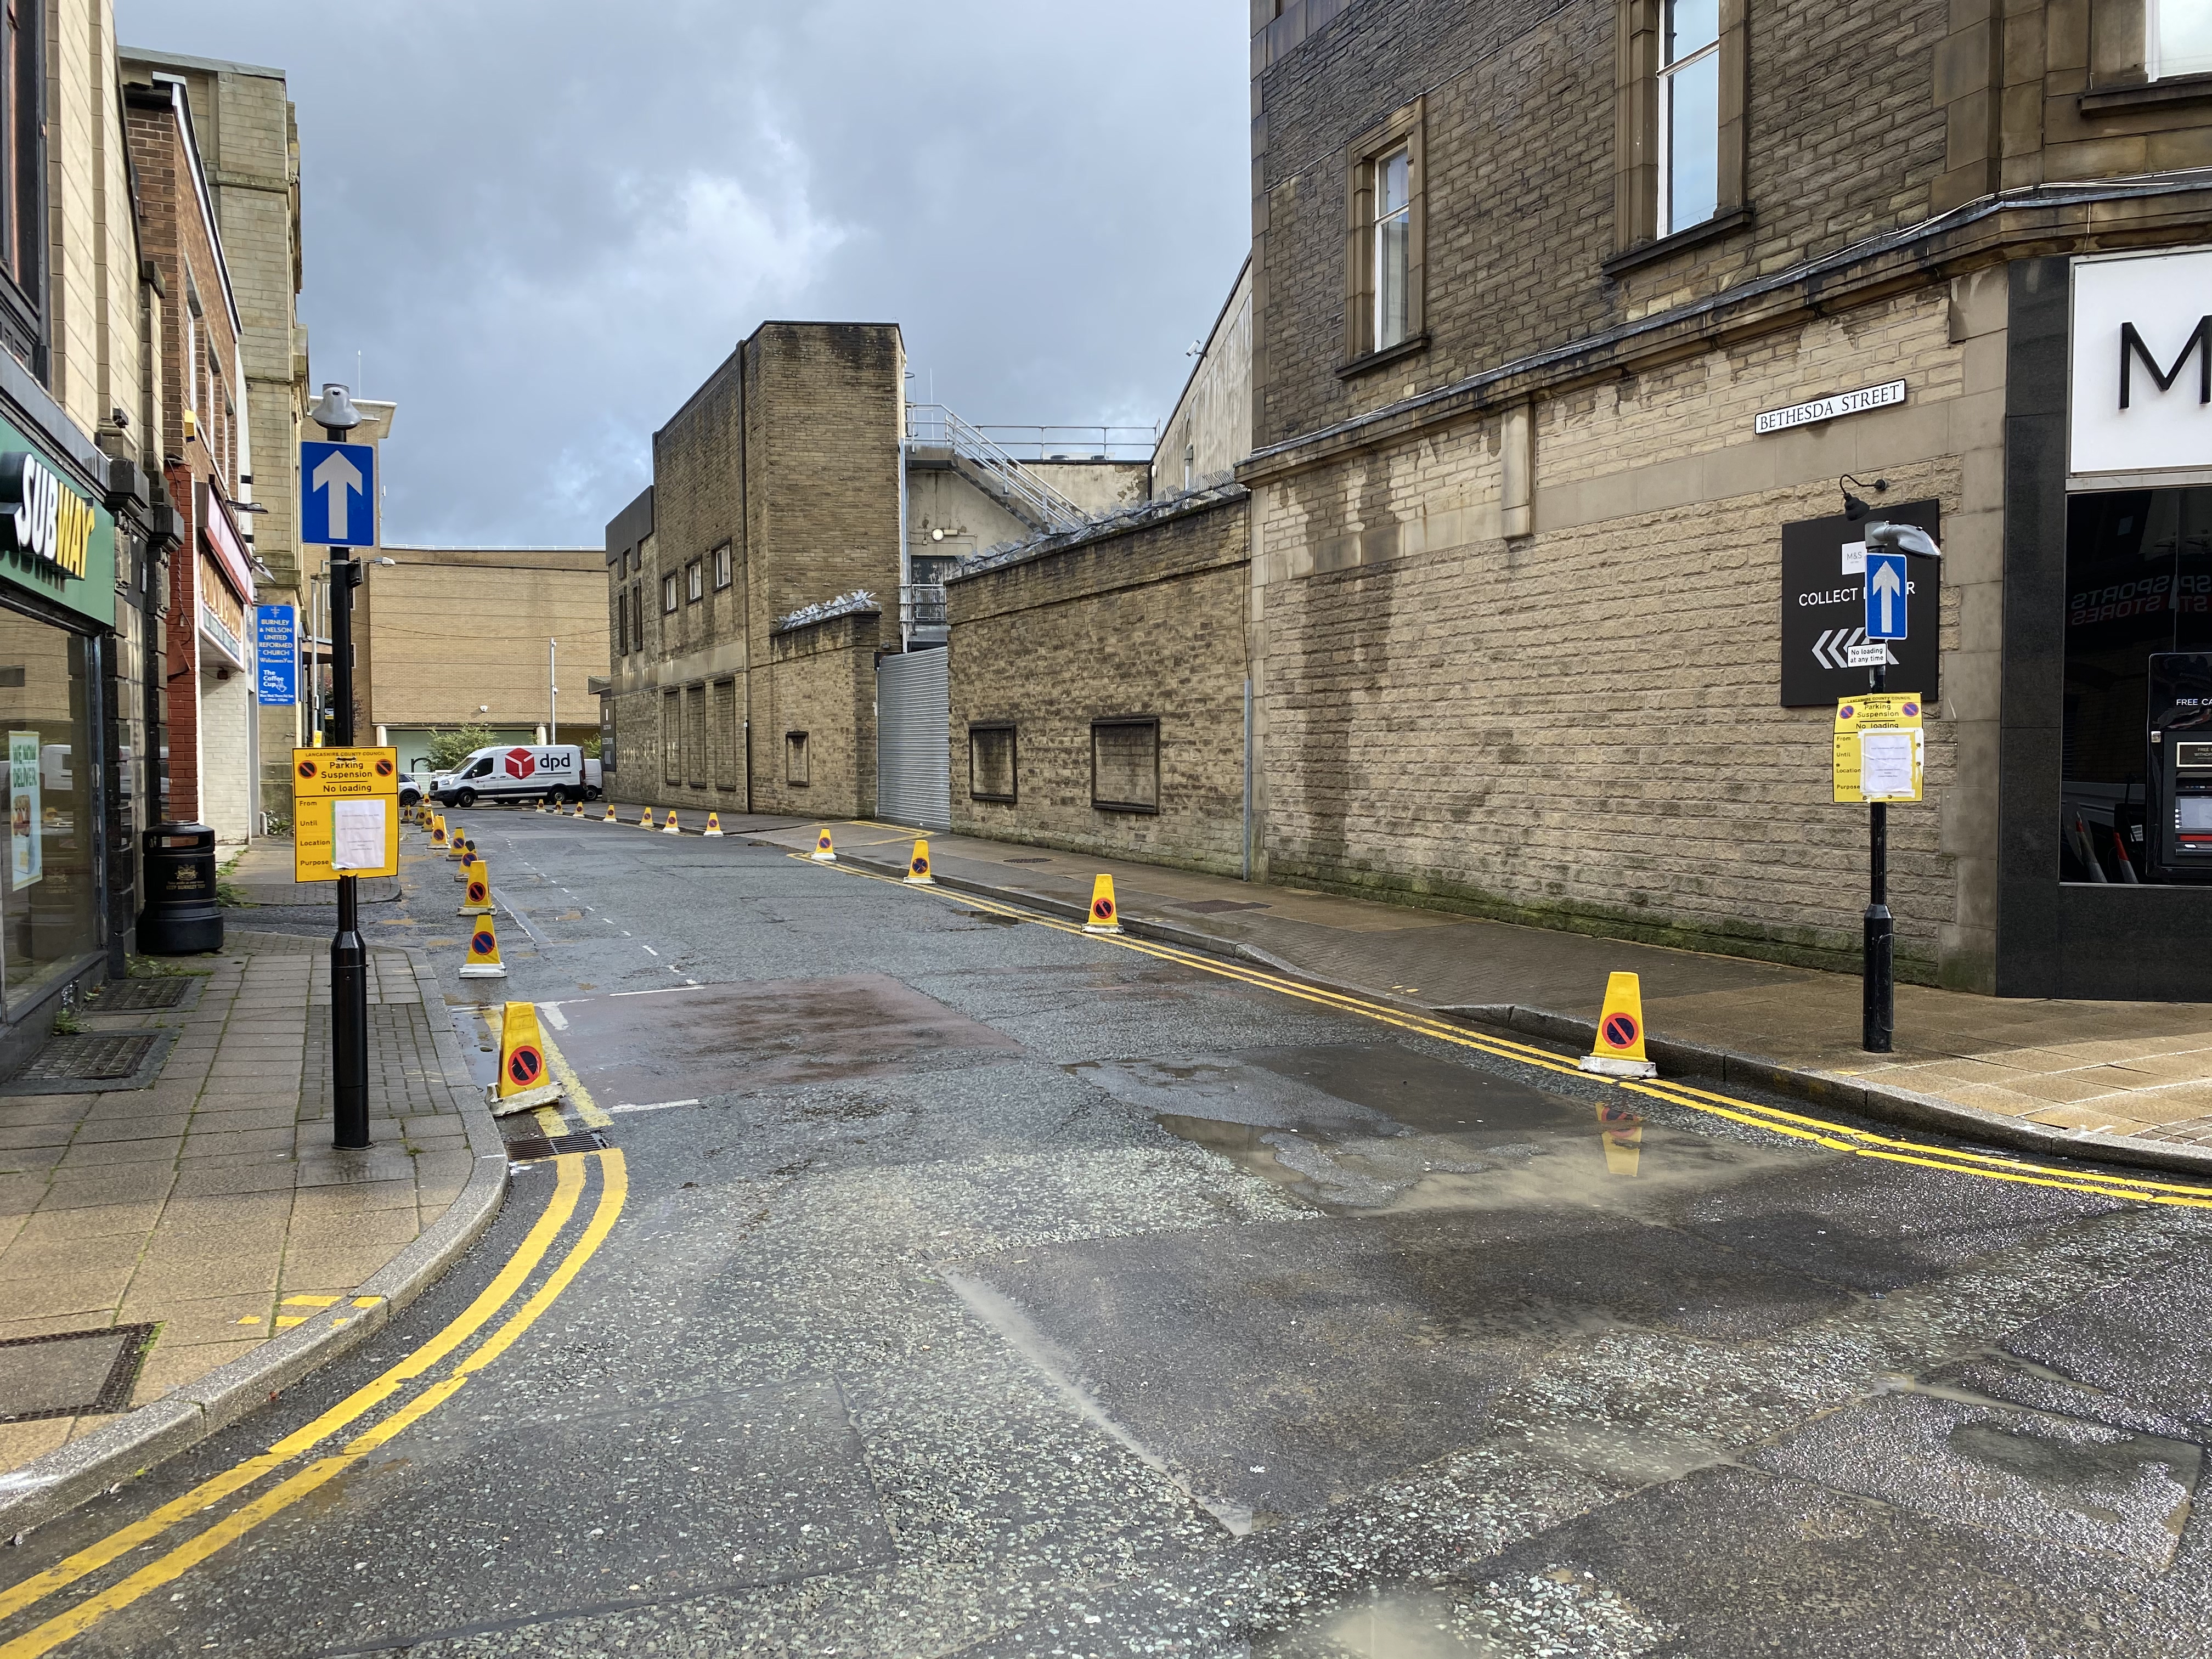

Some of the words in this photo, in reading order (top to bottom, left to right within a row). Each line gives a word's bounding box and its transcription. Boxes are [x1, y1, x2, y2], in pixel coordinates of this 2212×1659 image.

[1760, 401, 1834, 430] BETHESDA
[1841, 384, 1899, 411] STREET
[14, 453, 95, 580] SUBWAY
[1847, 551, 1862, 561] M&S
[1798, 588, 1858, 606] COLLECT
[13, 744, 22, 764] WE
[23, 743, 37, 760] NOW
[540, 753, 571, 771] dpd
[321, 771, 373, 779] Suspension
